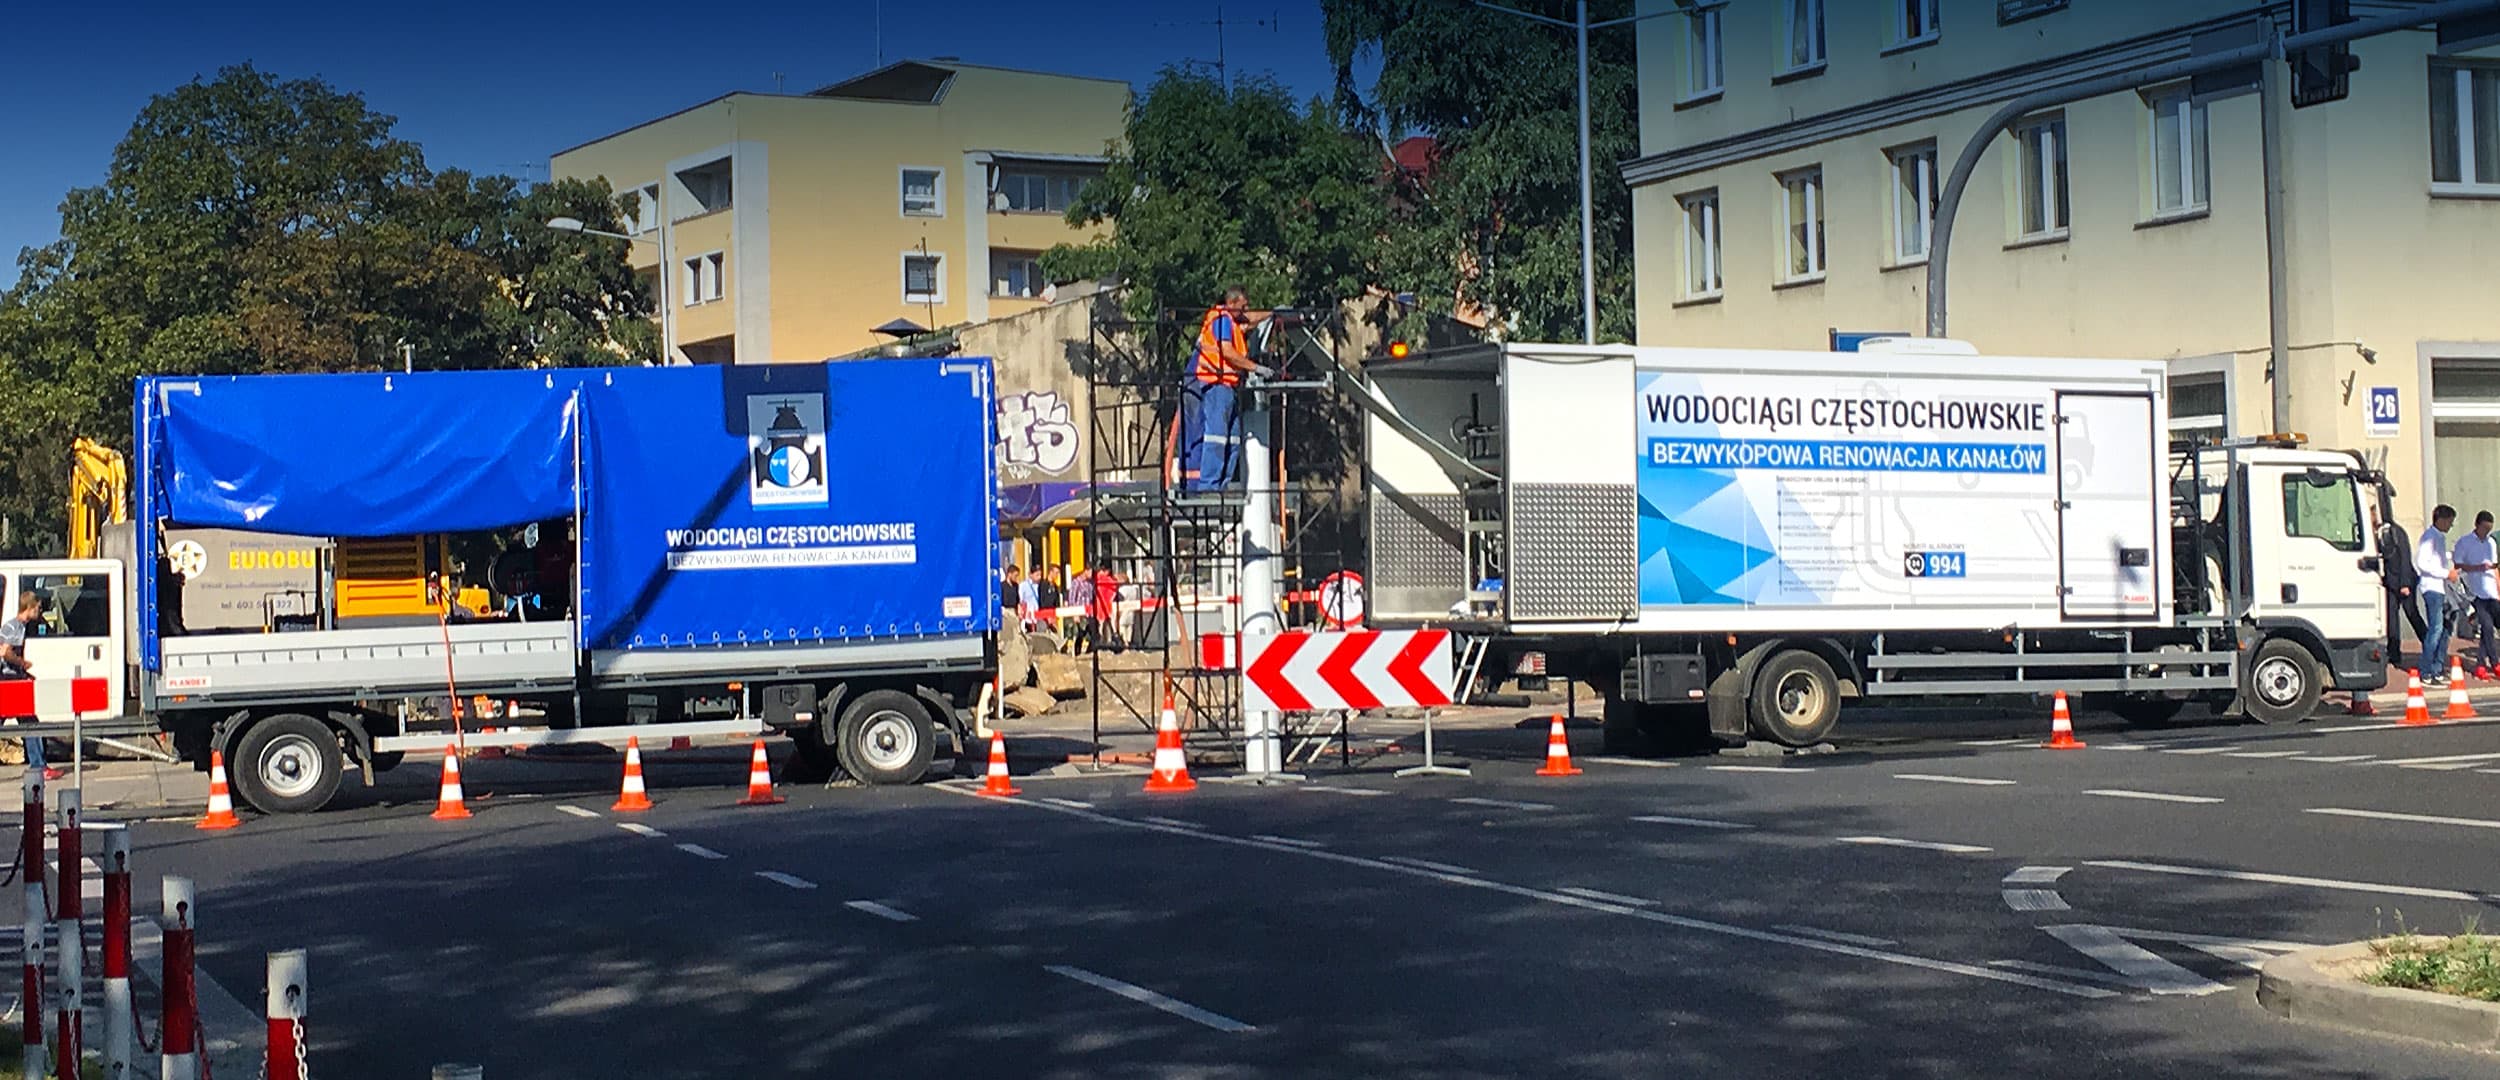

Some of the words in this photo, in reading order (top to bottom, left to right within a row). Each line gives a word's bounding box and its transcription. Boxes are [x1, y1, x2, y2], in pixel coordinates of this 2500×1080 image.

[1646, 394, 1802, 432] WODOCIĄGI
[1811, 398, 2045, 434] CZĘSTOCHOWSKIE
[2374, 394, 2396, 418] 26
[1653, 442, 1814, 466] BEZWYKOPOWA
[1819, 445, 1942, 468] RENOWACJA
[1946, 444, 2042, 470] KANAŁÓW
[666, 527, 764, 549] WODOCIĄGI
[766, 522, 916, 548] CZĘSTOCHOWSKIE
[672, 552, 769, 567] BEZWYKOPOWA
[772, 550, 849, 563] RENOWACJA
[852, 546, 912, 561] KANAŁÓW
[1930, 554, 1961, 574] 994
